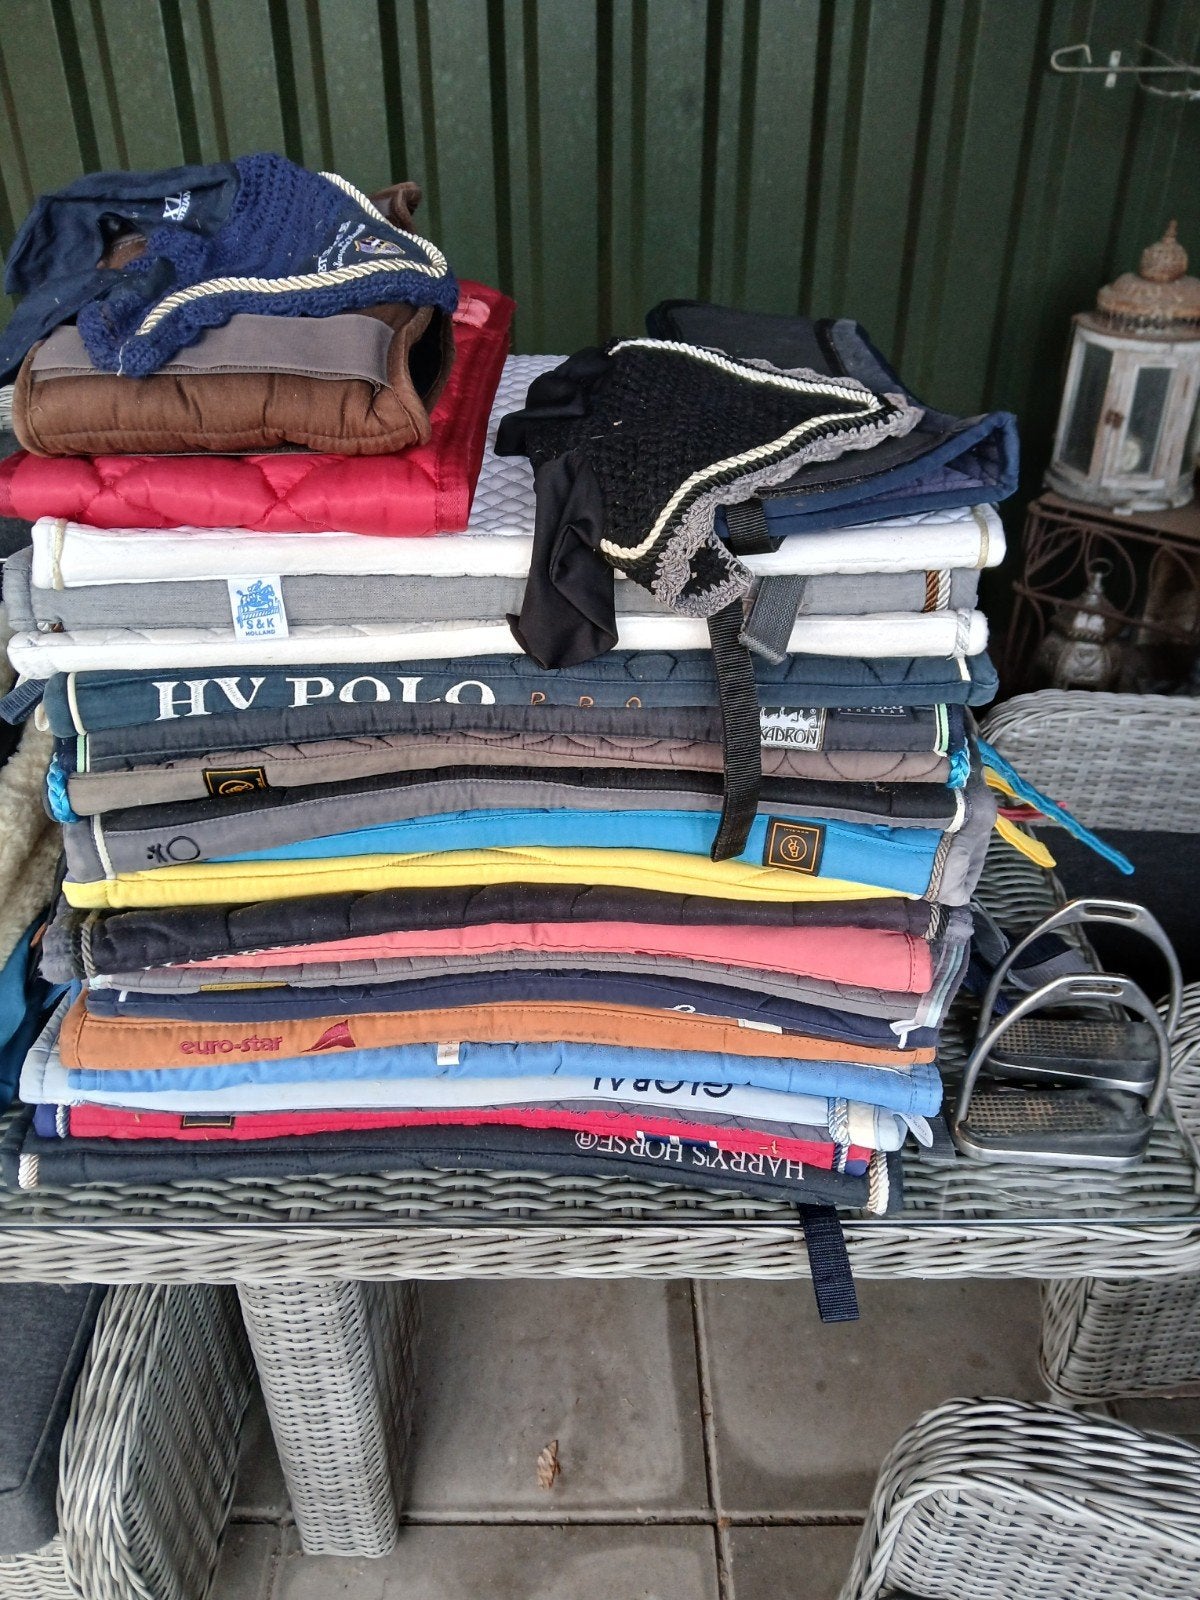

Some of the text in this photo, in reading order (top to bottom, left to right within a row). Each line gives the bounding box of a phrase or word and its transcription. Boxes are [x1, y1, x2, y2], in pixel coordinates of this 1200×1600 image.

[246, 618, 275, 629] S & K
[152, 676, 266, 721] HV
[285, 676, 495, 707] POLO
[760, 726, 817, 745] KADRON
[180, 1035, 283, 1055] euro-star
[692, 1147, 804, 1181] HARRY'S
